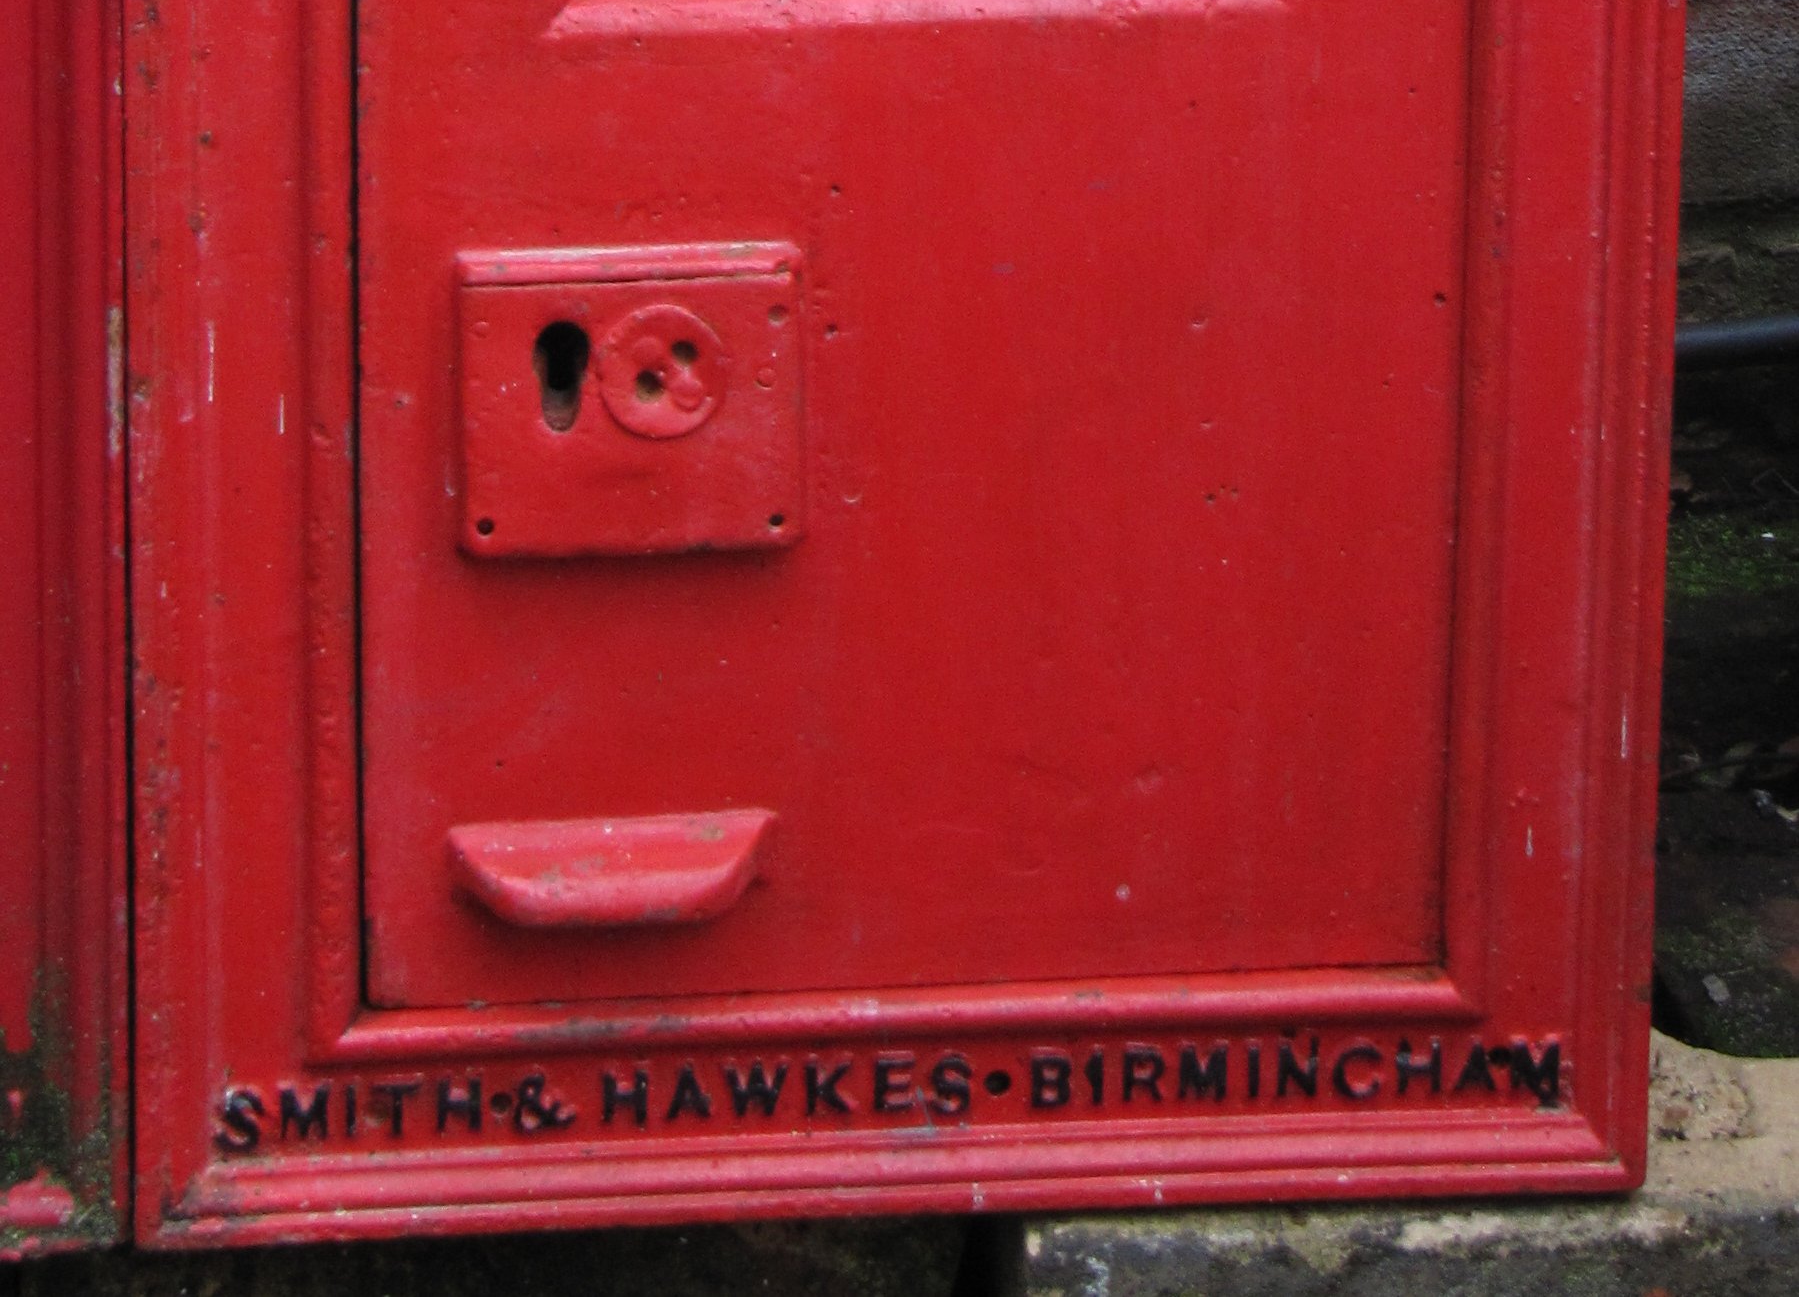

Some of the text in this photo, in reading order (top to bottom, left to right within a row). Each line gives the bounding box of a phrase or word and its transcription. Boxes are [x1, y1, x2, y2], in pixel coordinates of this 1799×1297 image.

[214, 1075, 483, 1152] SMITH
[513, 1073, 576, 1132] &
[603, 1053, 974, 1122] HAWKES
